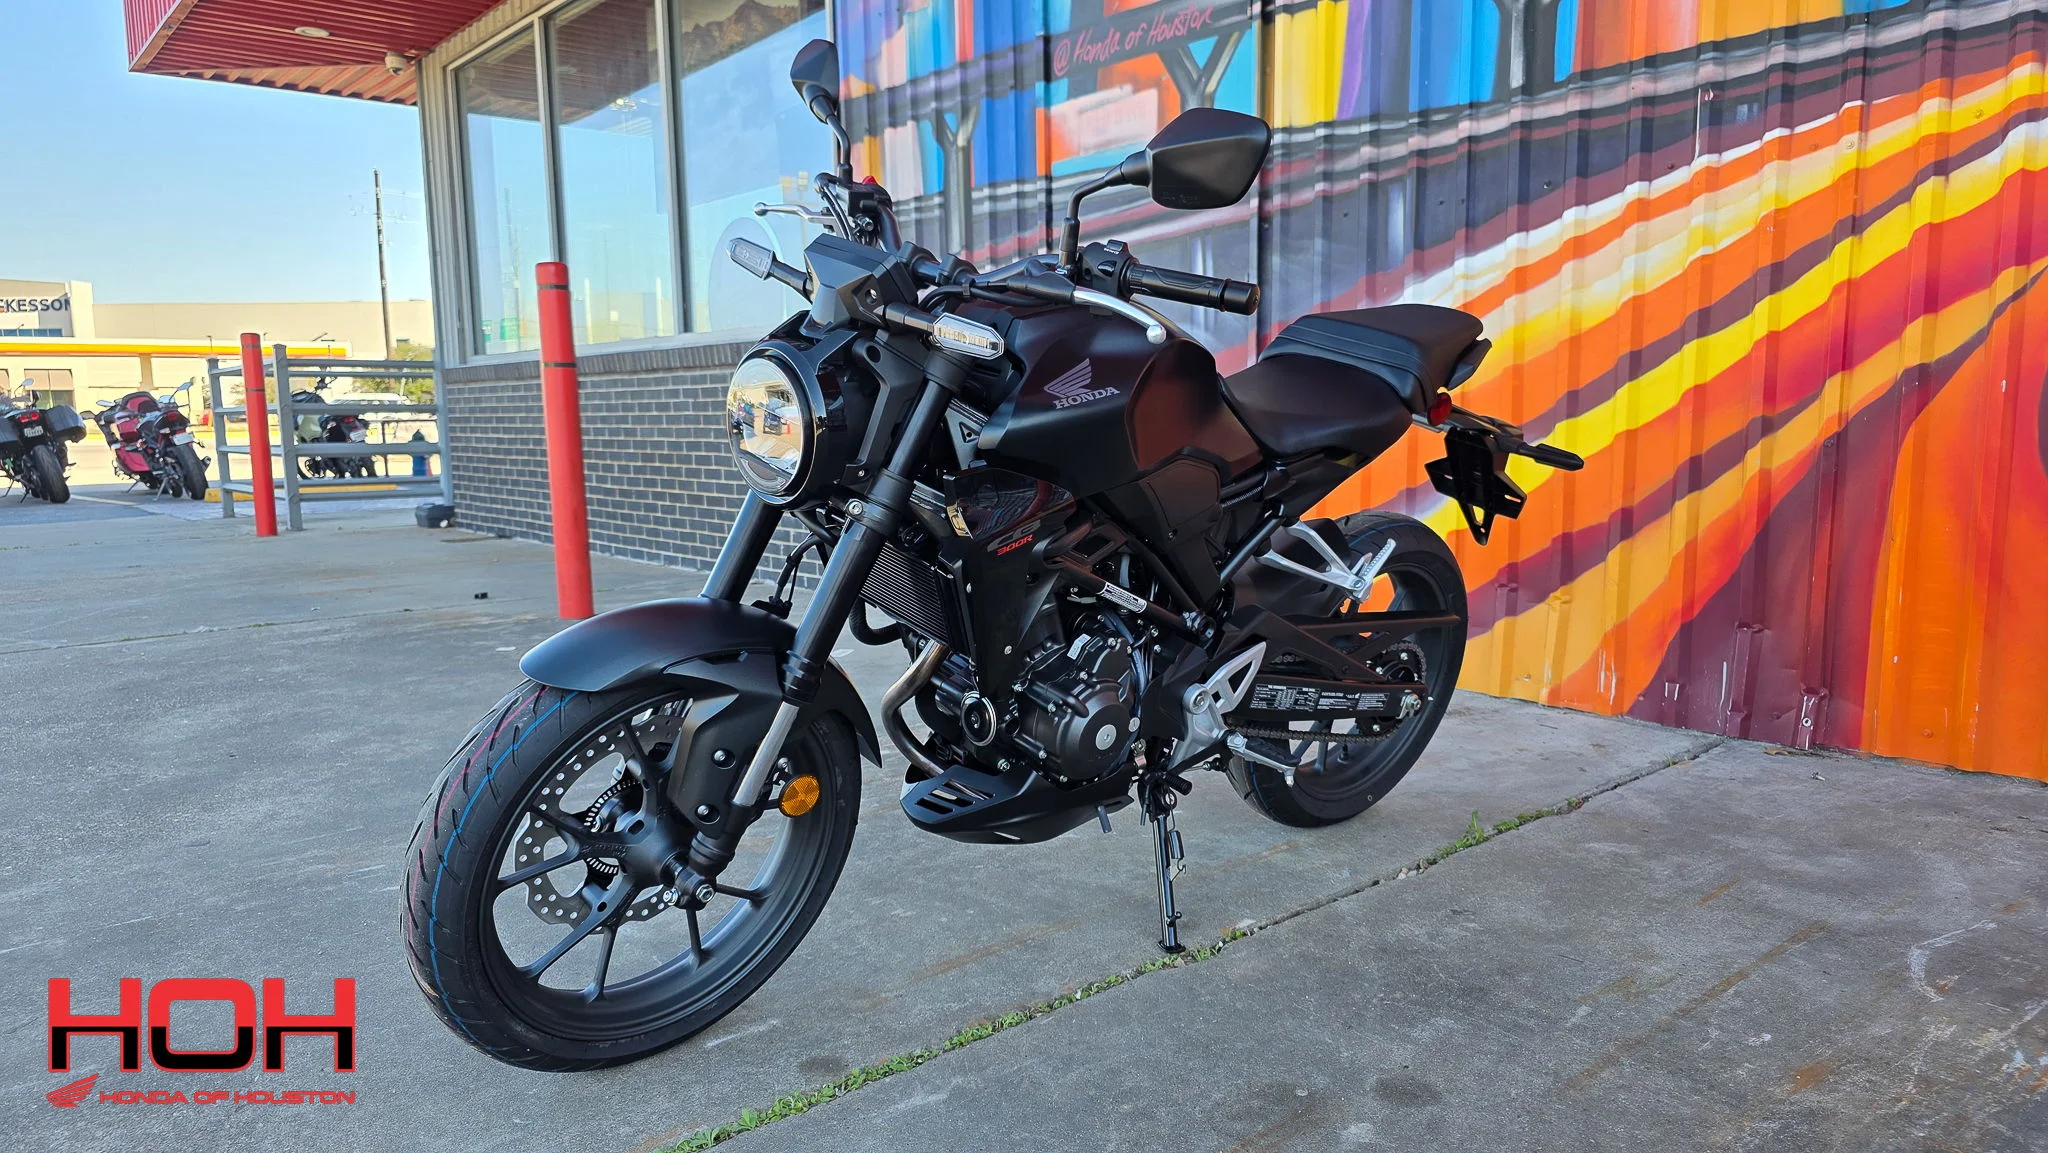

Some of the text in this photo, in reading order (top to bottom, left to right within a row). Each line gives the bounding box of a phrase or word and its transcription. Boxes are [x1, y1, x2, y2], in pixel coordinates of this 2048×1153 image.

[1054, 6, 1213, 77] @ Honda of Houston
[1054, 386, 1120, 409] HONDA
[996, 534, 1033, 556] 300R
